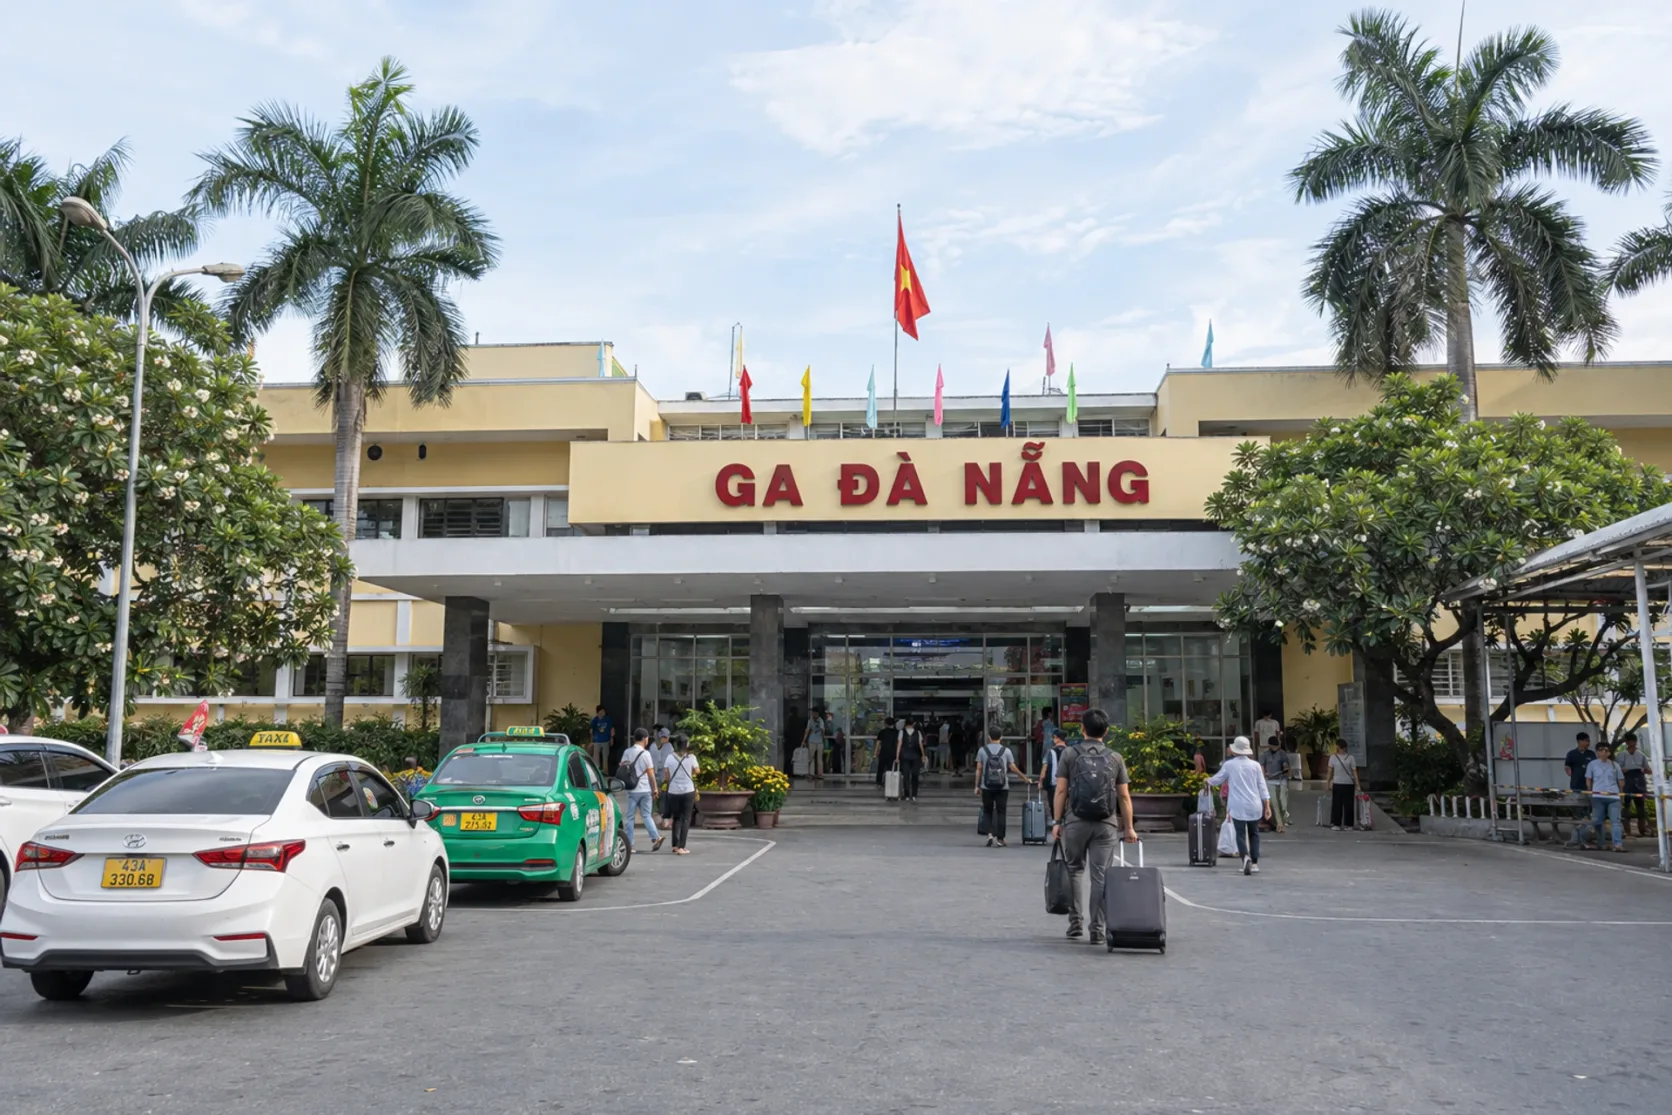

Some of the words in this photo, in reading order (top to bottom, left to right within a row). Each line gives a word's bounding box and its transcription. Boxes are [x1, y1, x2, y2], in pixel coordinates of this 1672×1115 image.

[715, 463, 803, 507] GA
[837, 451, 928, 507] ĐÀ
[964, 441, 1150, 506] NẴNG
[121, 859, 146, 872] 43A
